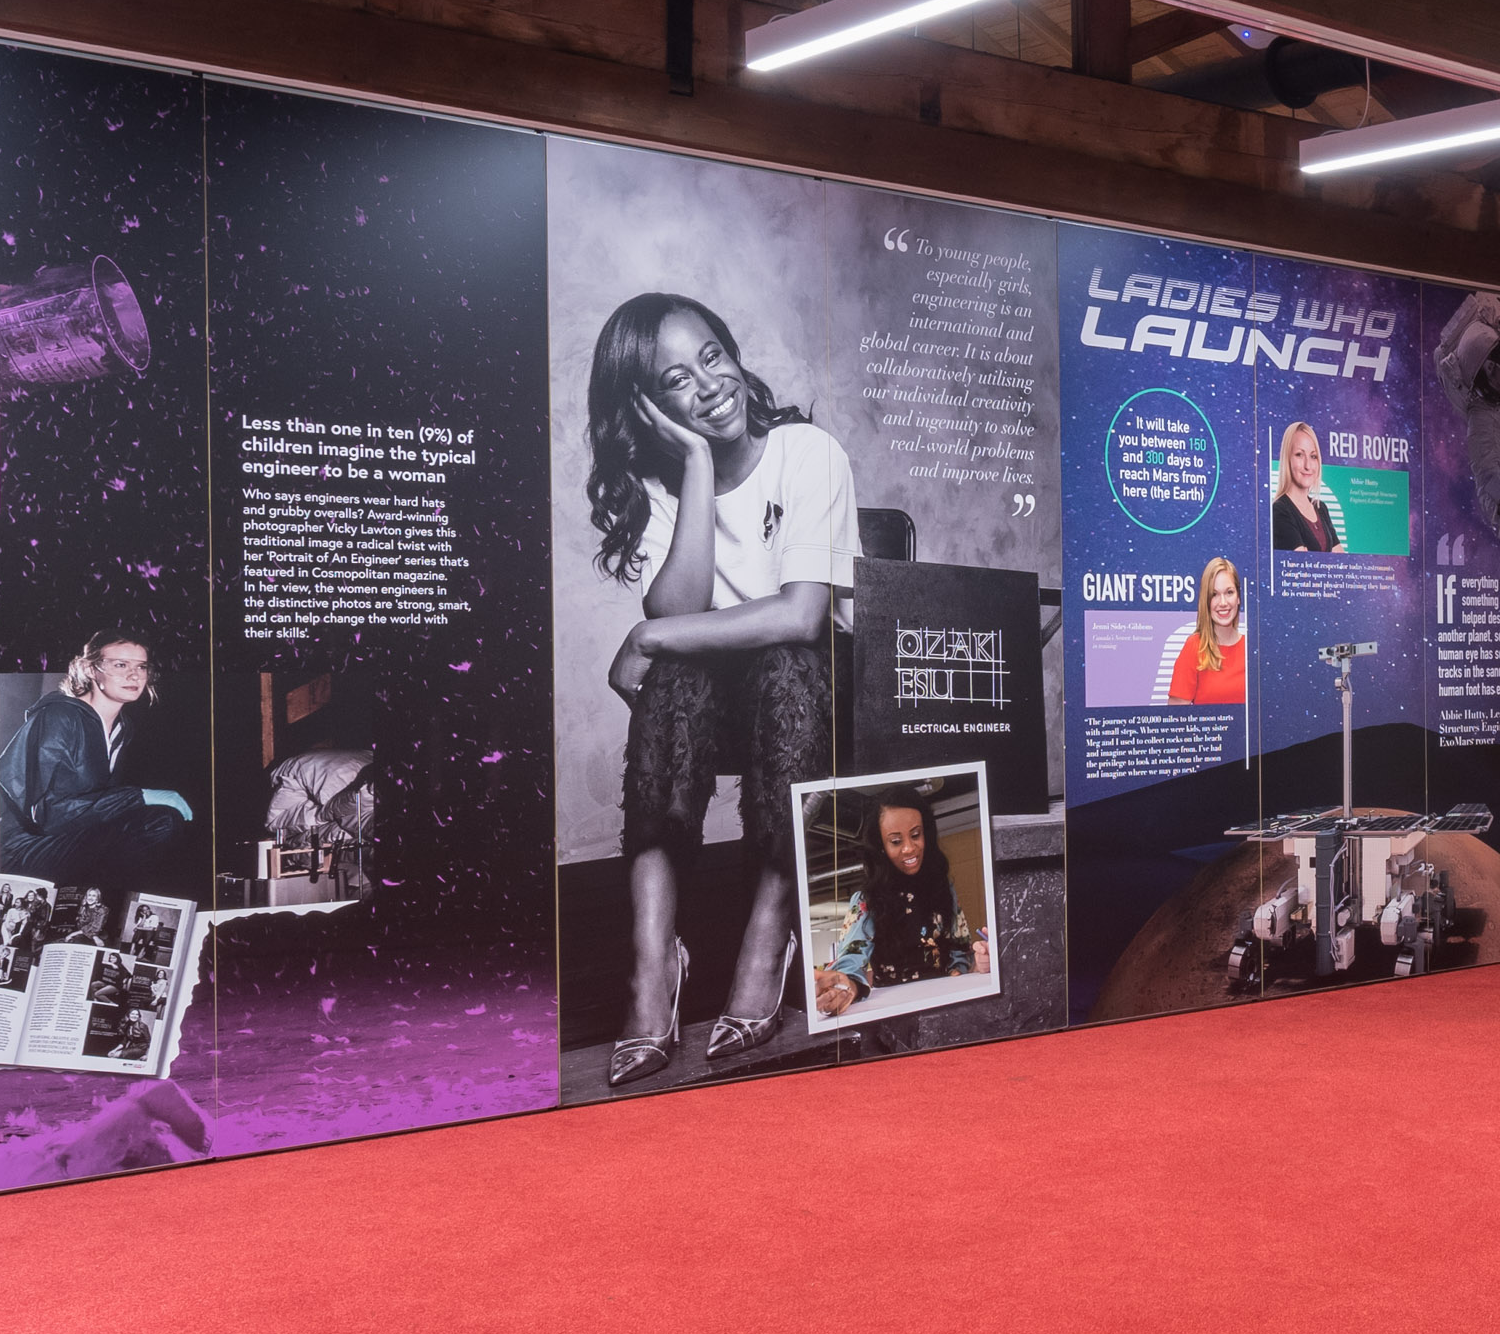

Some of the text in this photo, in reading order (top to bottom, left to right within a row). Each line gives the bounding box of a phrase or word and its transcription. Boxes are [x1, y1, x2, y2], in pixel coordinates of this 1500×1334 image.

[927, 270, 1031, 296] especially girls,
[1088, 267, 1396, 339] LADIES WHO
[1080, 305, 1390, 381] LAUNCH
[866, 360, 1034, 392] collaboratively utilising
[243, 415, 474, 445] Less than one in ten (9%) of
[1137, 416, 1189, 433] It will take
[242, 437, 475, 466] children imagine the typical
[890, 435, 1034, 460] real-world problems
[1119, 435, 1206, 451] you between 150
[1330, 432, 1408, 463] RED ROVER
[243, 460, 445, 483] engineer to be a woman
[1123, 451, 1203, 469] and 300 days to
[1120, 468, 1206, 484] reach Mars from
[1123, 483, 1204, 502] here (the Earth)
[244, 520, 456, 539] photographer Vicky Lawton gives this
[244, 565, 447, 583] featured in Cosmopolitan magazine.
[1462, 576, 1498, 591] everything
[1084, 573, 1194, 602] GIANT STEPS
[1437, 574, 1456, 624] If
[1462, 611, 1486, 627] helped
[902, 723, 1010, 733] ELECTRICAL ENGINEER
